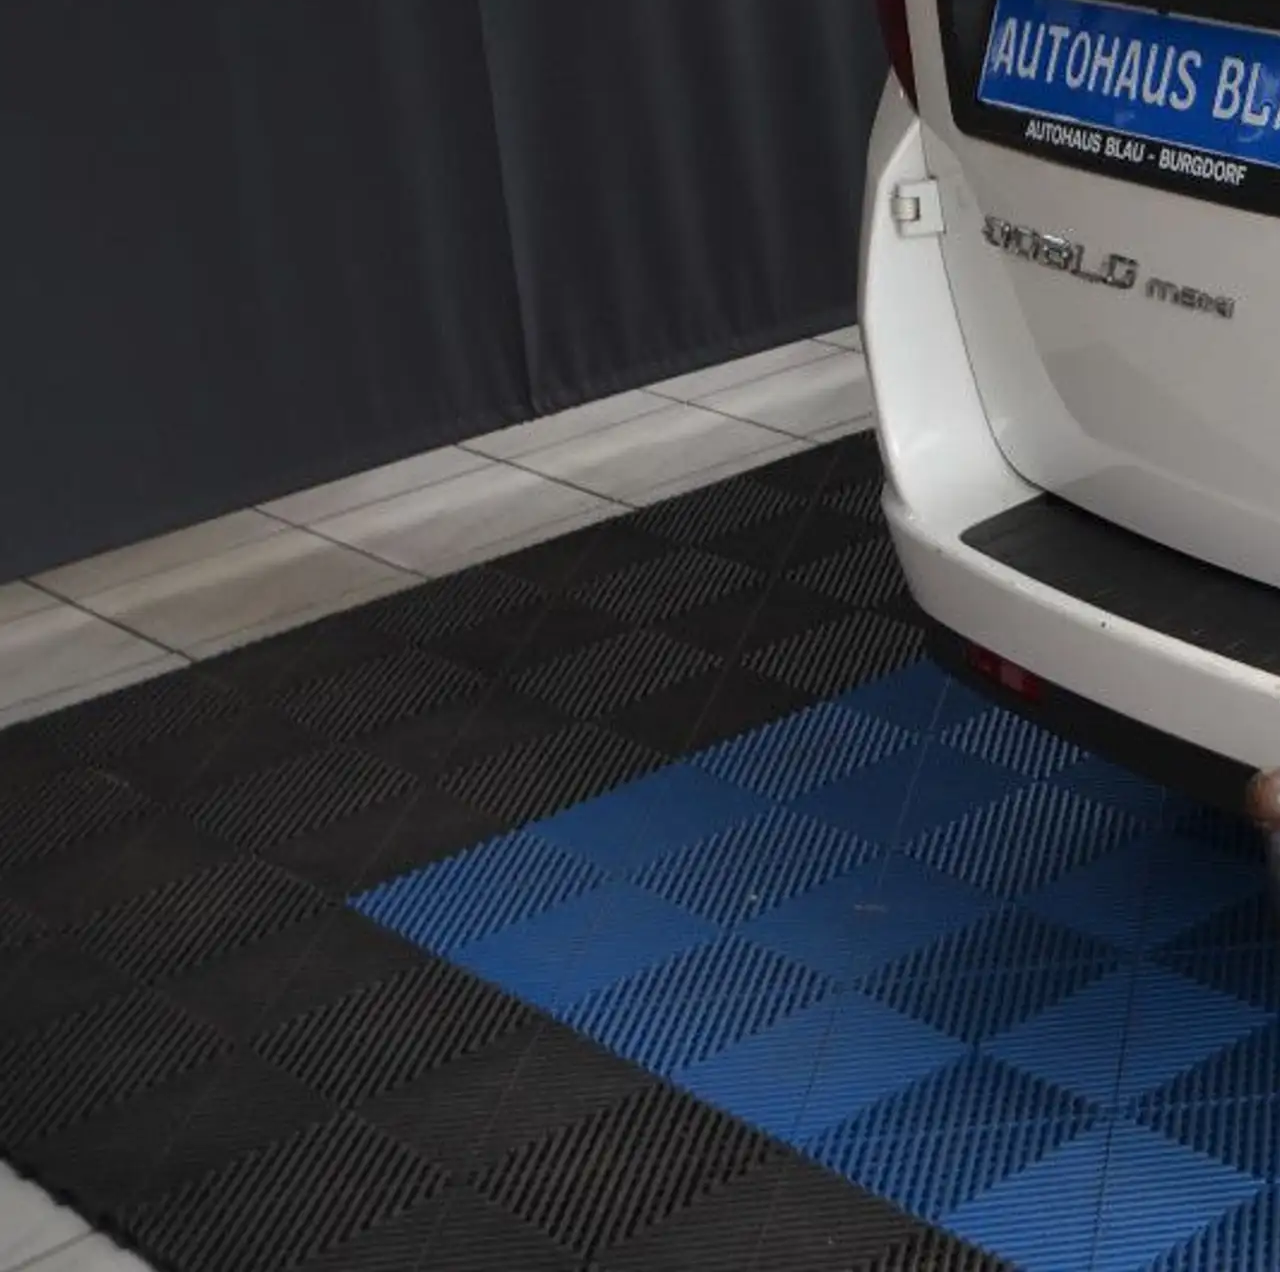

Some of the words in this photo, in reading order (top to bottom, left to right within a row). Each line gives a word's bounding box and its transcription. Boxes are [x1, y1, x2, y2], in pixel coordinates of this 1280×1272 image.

[993, 17, 1202, 111] AUTOHAUS
[1024, 119, 1102, 153] AUTOHAUS
[1104, 136, 1145, 163] BLAU
[1158, 148, 1248, 186] BURGDORF
